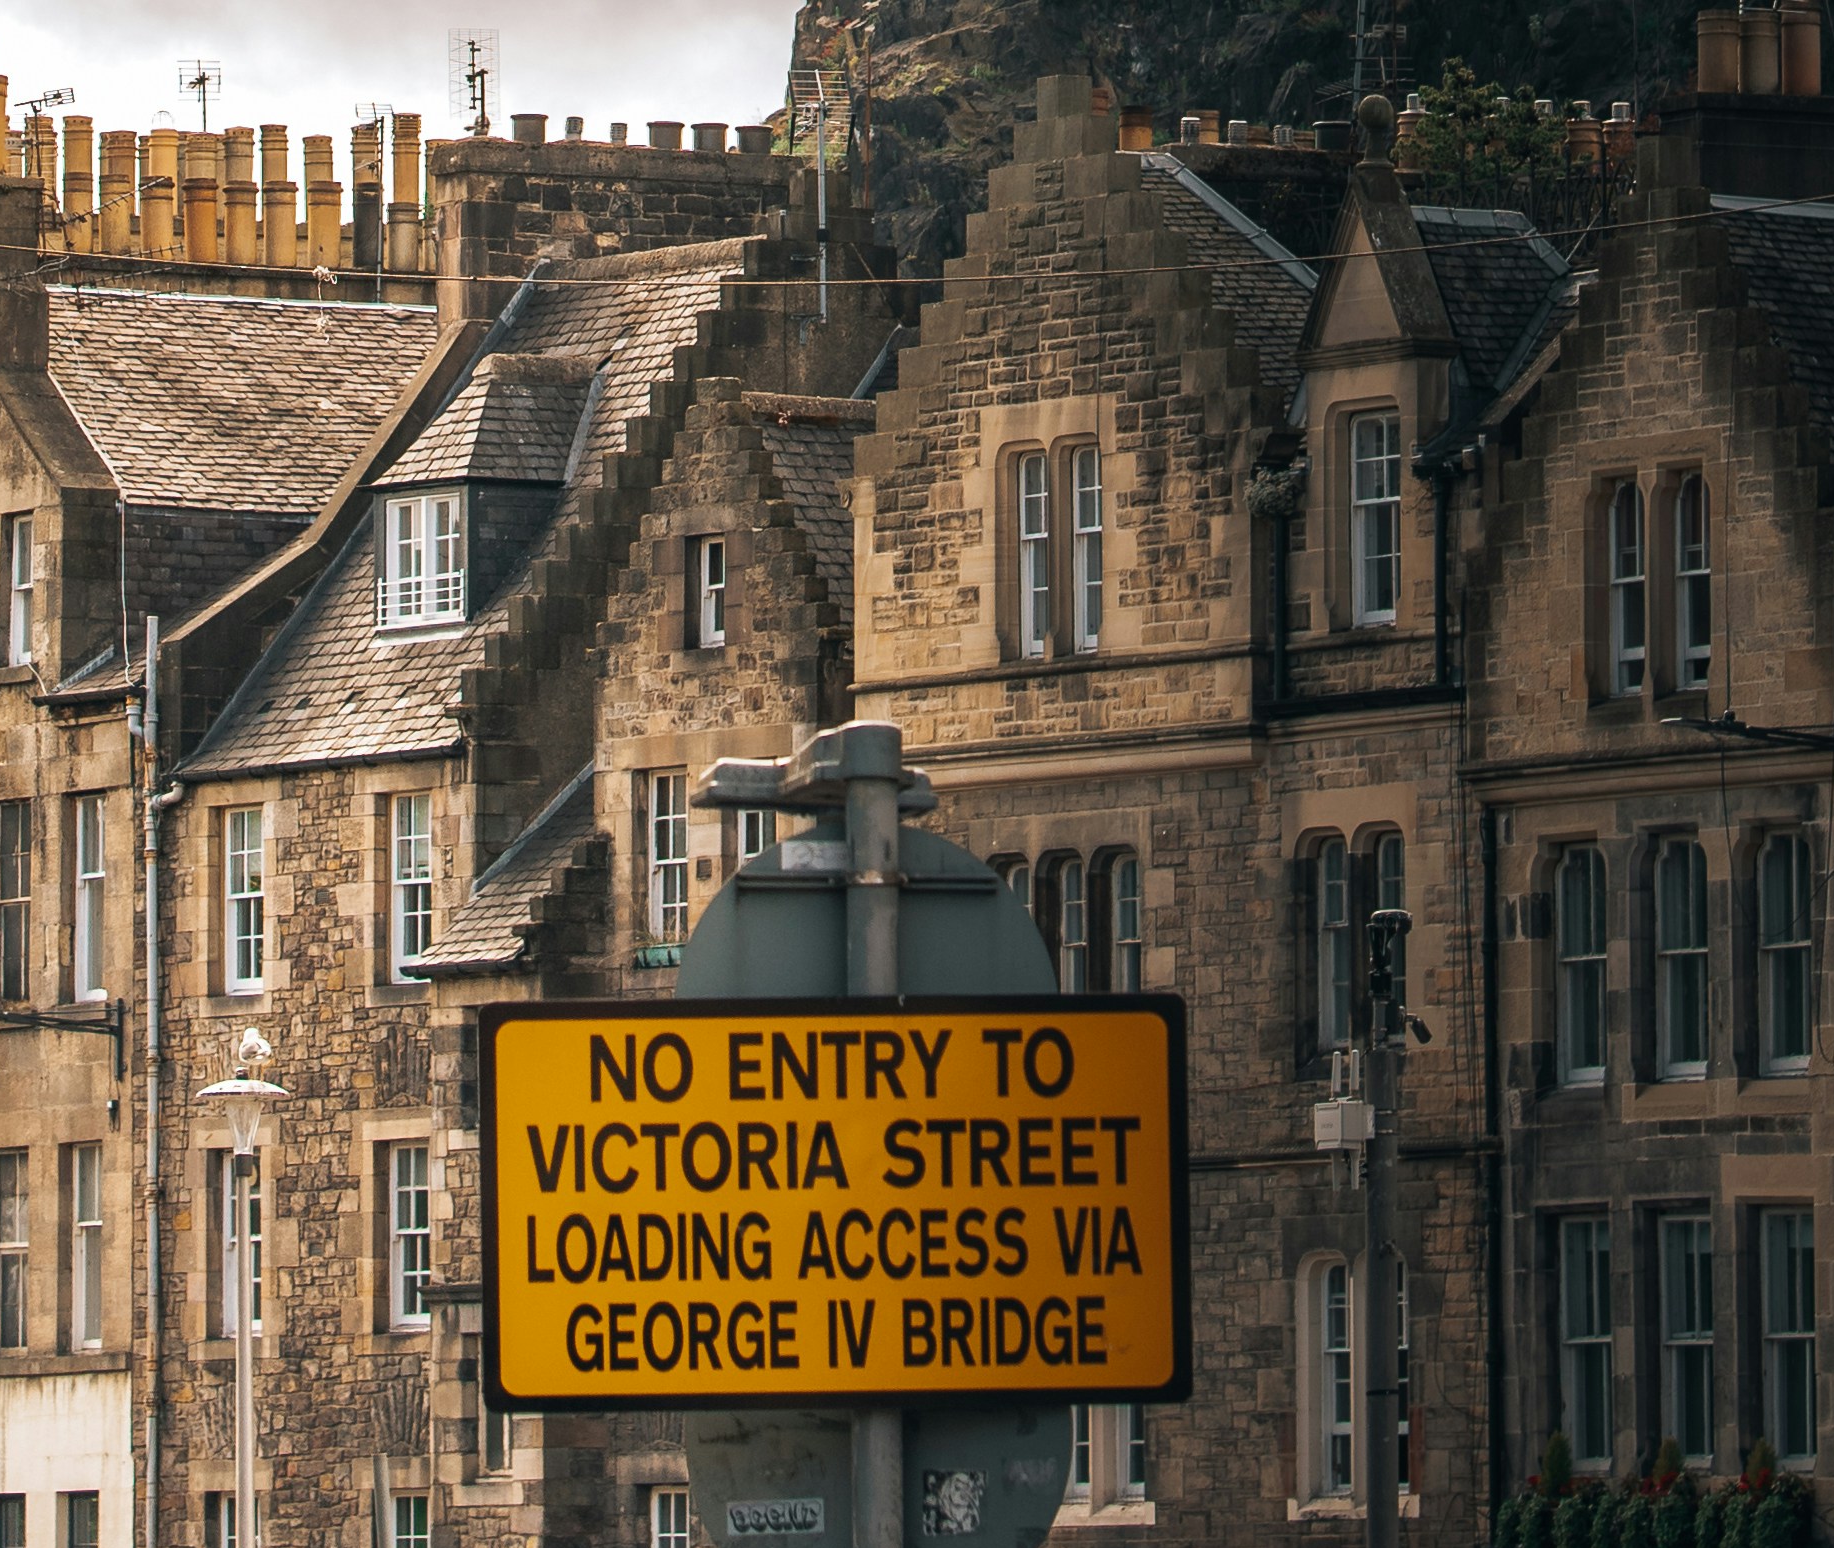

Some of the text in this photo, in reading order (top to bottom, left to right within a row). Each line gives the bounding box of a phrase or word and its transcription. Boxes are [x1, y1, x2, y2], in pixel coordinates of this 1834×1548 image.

[590, 1026, 1074, 1103] NO ENTRY TO
[526, 1116, 1141, 1194] VICTORIA STREET
[527, 1206, 1143, 1284] LOADING ACCESS VIA
[566, 1295, 1108, 1374] GEORGE IV BRIDGE
